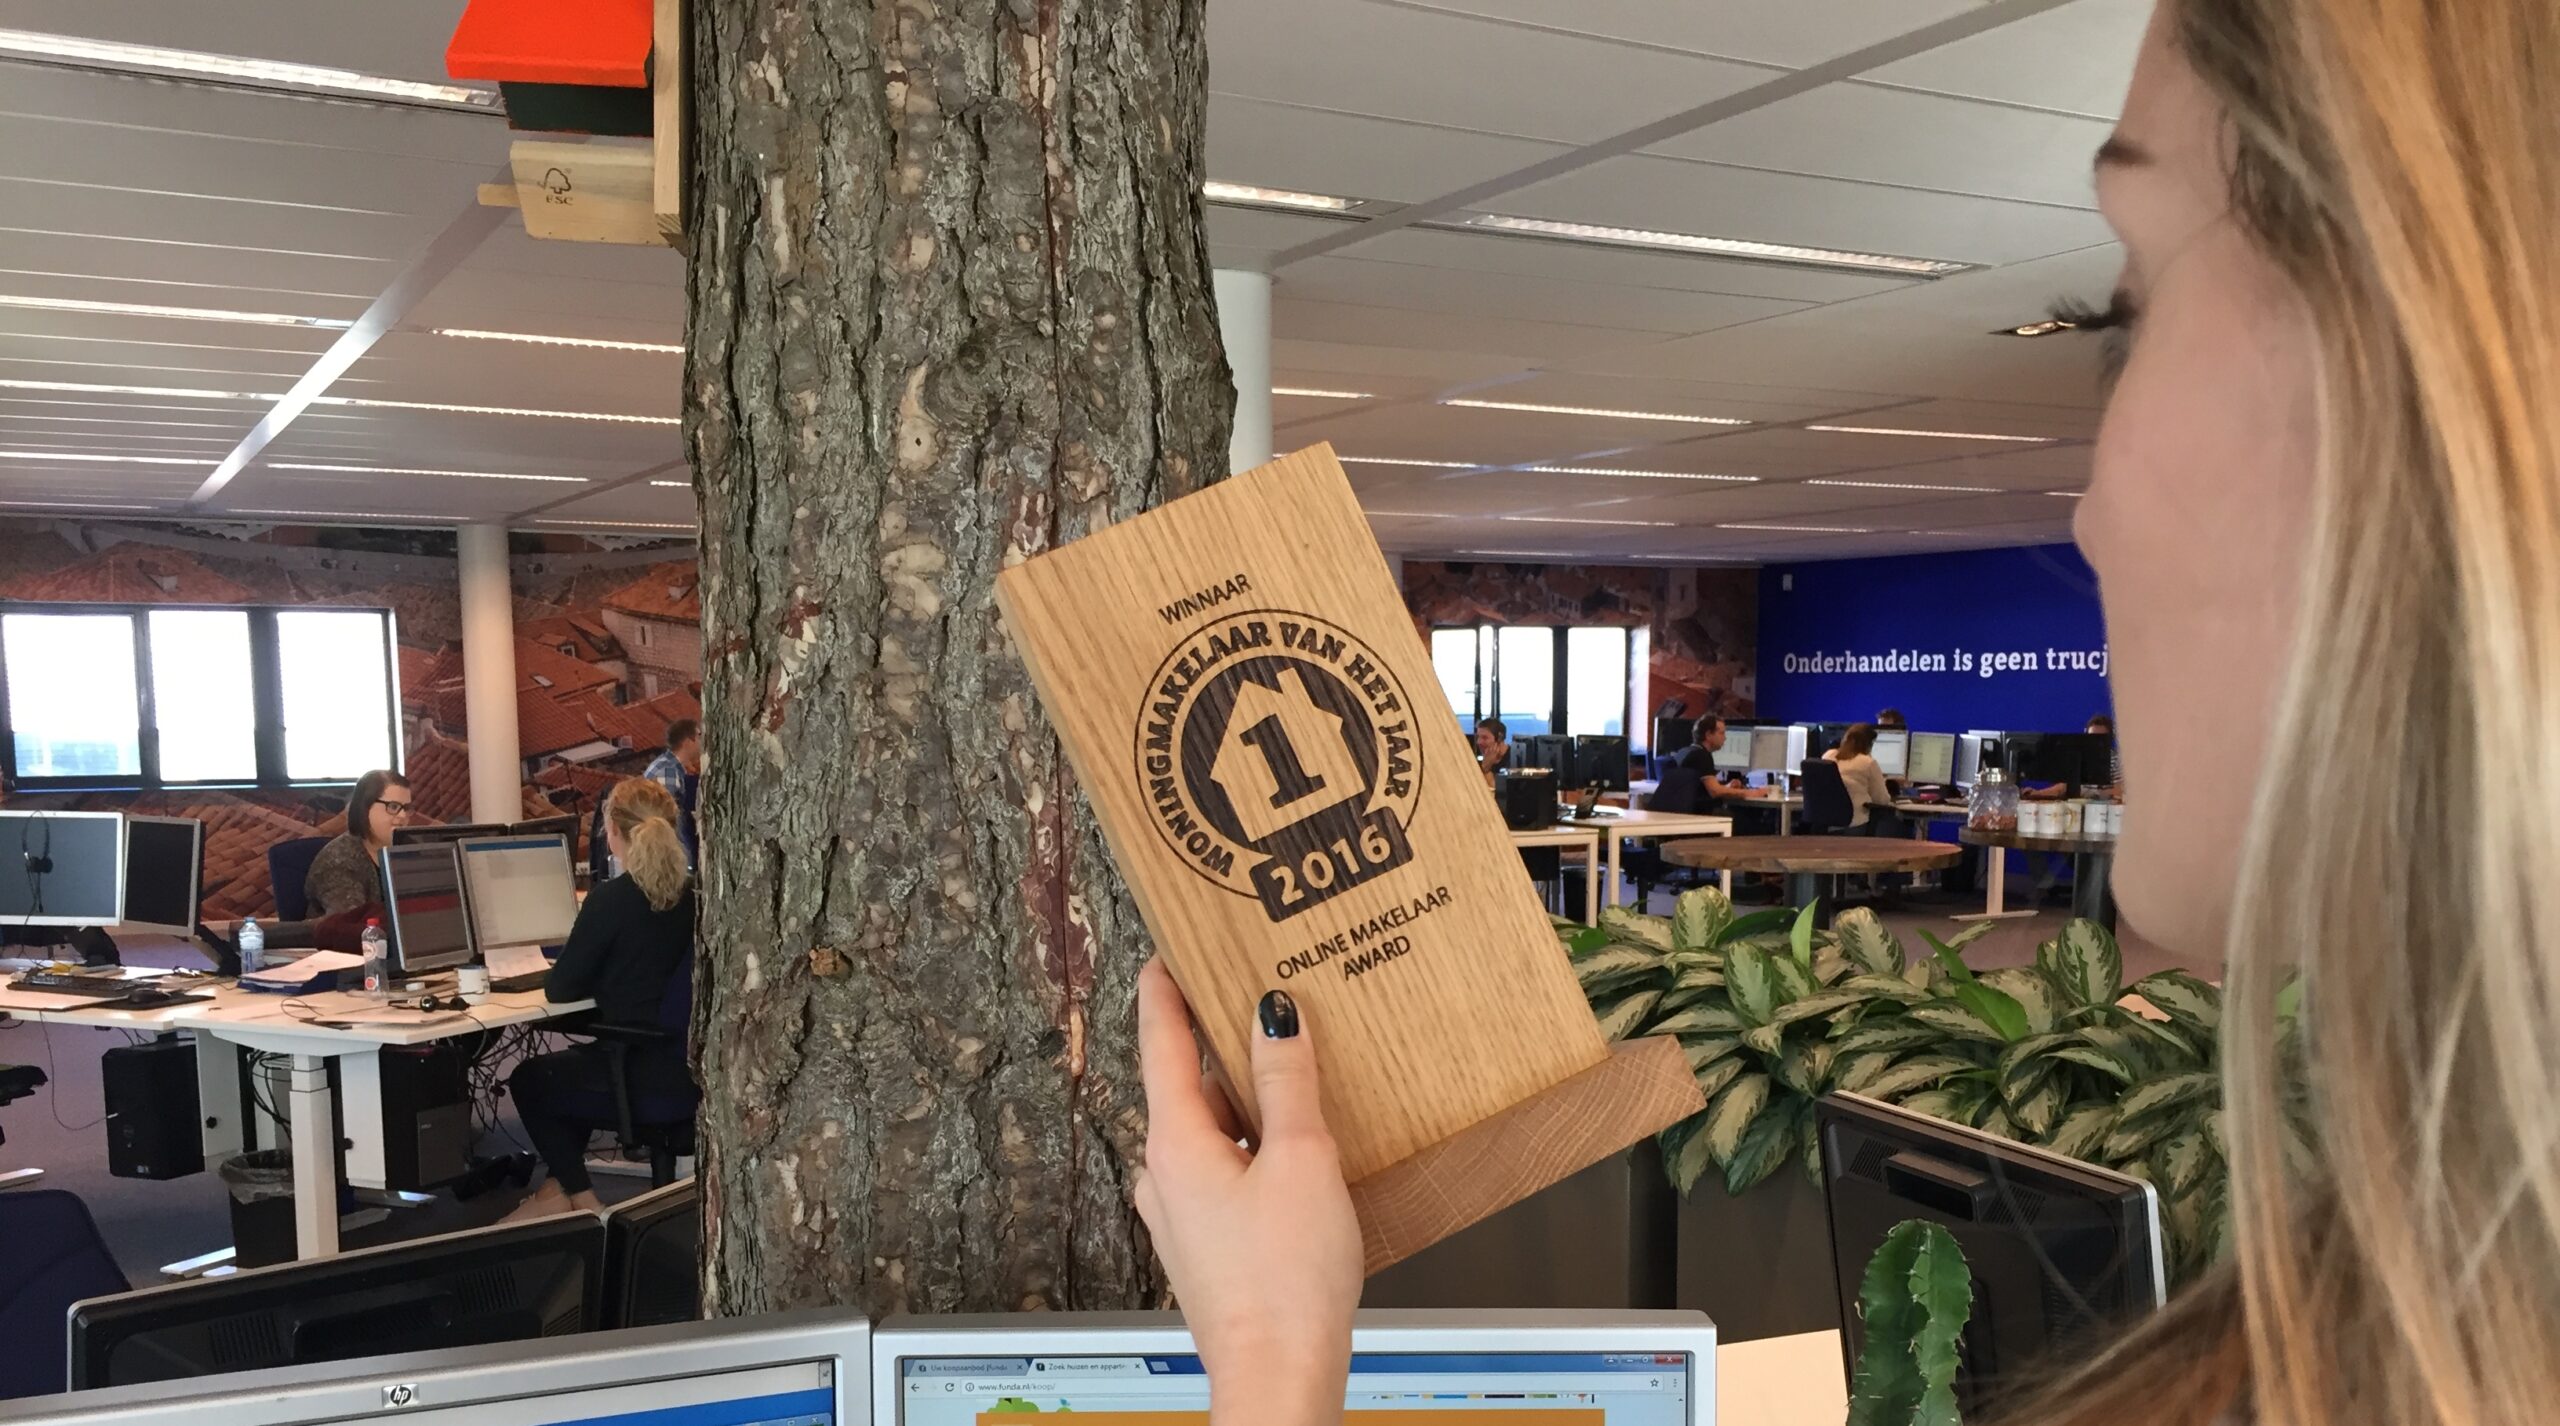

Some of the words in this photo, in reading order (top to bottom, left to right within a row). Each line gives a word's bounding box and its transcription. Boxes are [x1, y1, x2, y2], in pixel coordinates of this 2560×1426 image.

[1158, 574, 1253, 626] WINNAAR
[1783, 649, 1947, 674] Onderhandelen
[1953, 648, 1973, 672] is
[1979, 648, 2039, 678] geen
[1146, 621, 1273, 878] WONINGMAKELAAR
[1278, 621, 1347, 662] VAN
[1343, 653, 1402, 724] HET
[1379, 720, 1413, 799] JAAR
[1238, 713, 1327, 811] 1
[1269, 824, 1392, 906] 2016
[1275, 933, 1350, 980] ONLINE
[1349, 885, 1453, 946] MAKELAAR
[1341, 934, 1412, 981] AWARD
